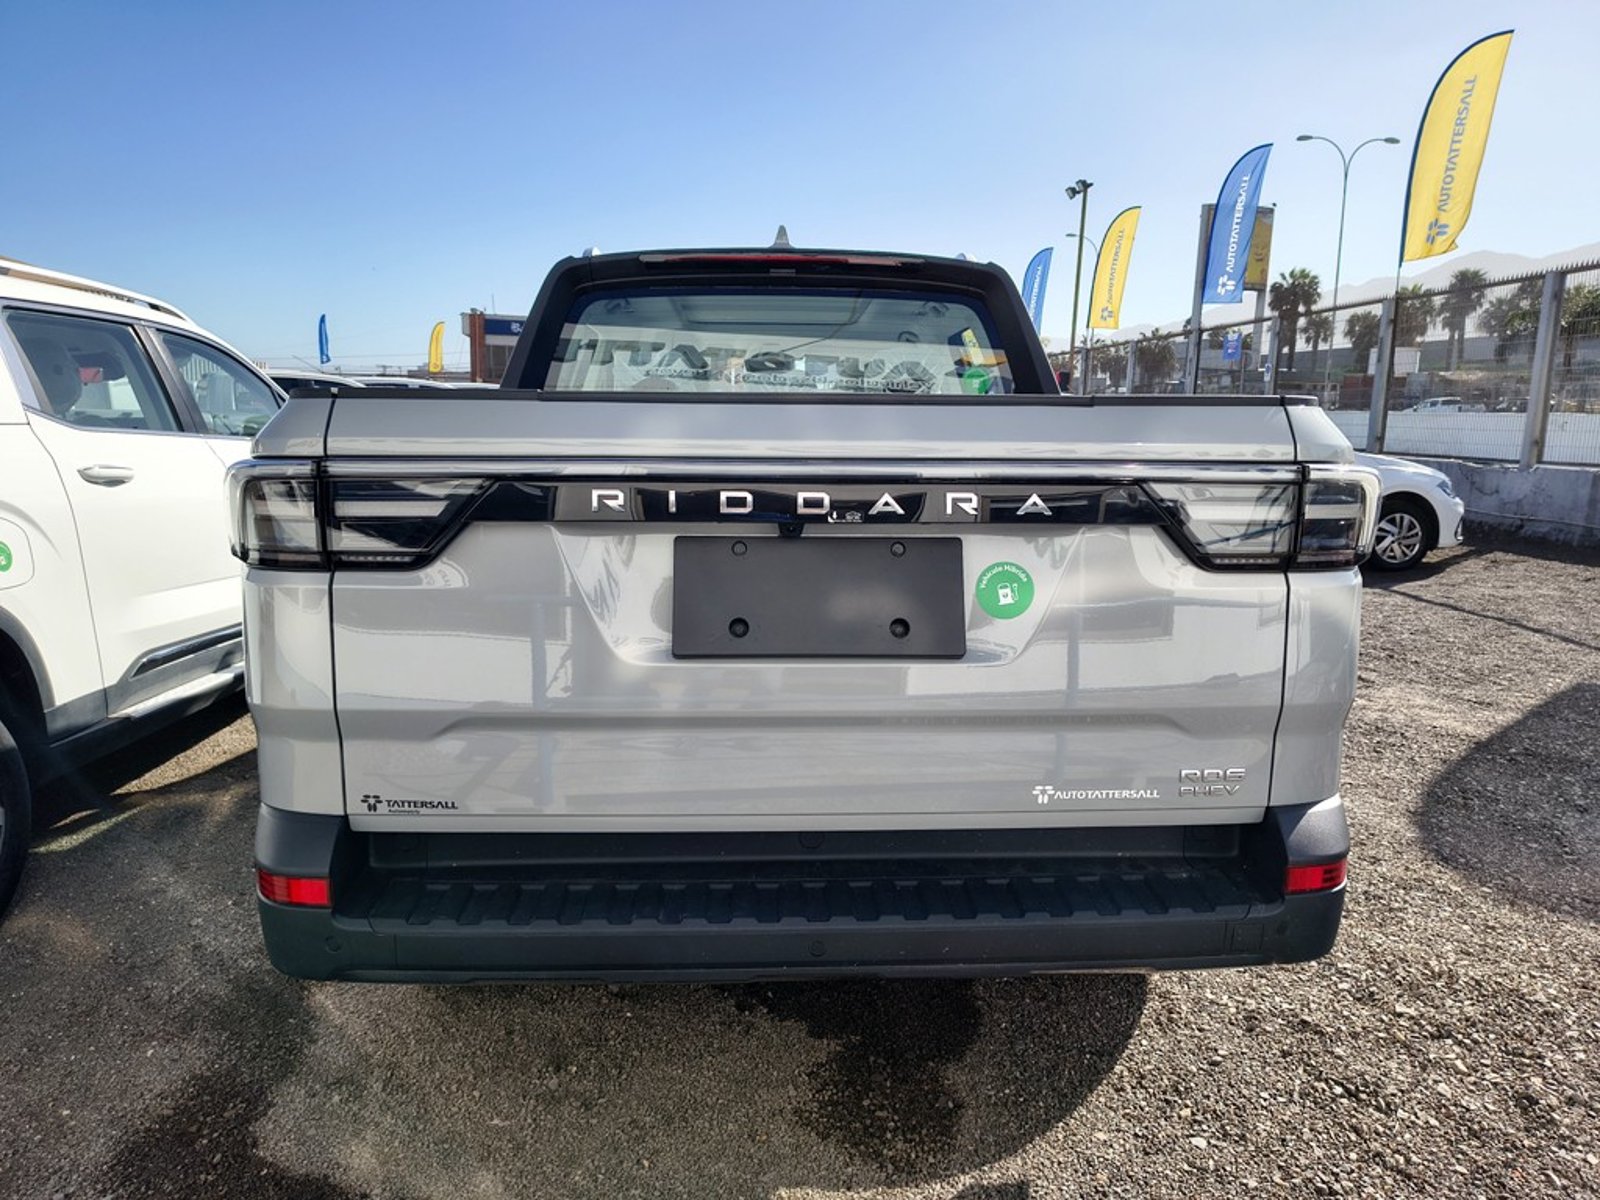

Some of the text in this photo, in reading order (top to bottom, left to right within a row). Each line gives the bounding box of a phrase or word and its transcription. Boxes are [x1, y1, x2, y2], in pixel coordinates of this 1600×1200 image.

[1437, 74, 1478, 212] AUTOTATTERSALL
[1225, 173, 1251, 273] AUTOTATTERSALL
[591, 489, 1053, 517] RIDDARA
[1179, 768, 1246, 783] RD6
[1054, 789, 1160, 800] AUTOTATTERSALL
[1179, 784, 1241, 797] PHEV
[385, 799, 459, 810] TATTERSALL
